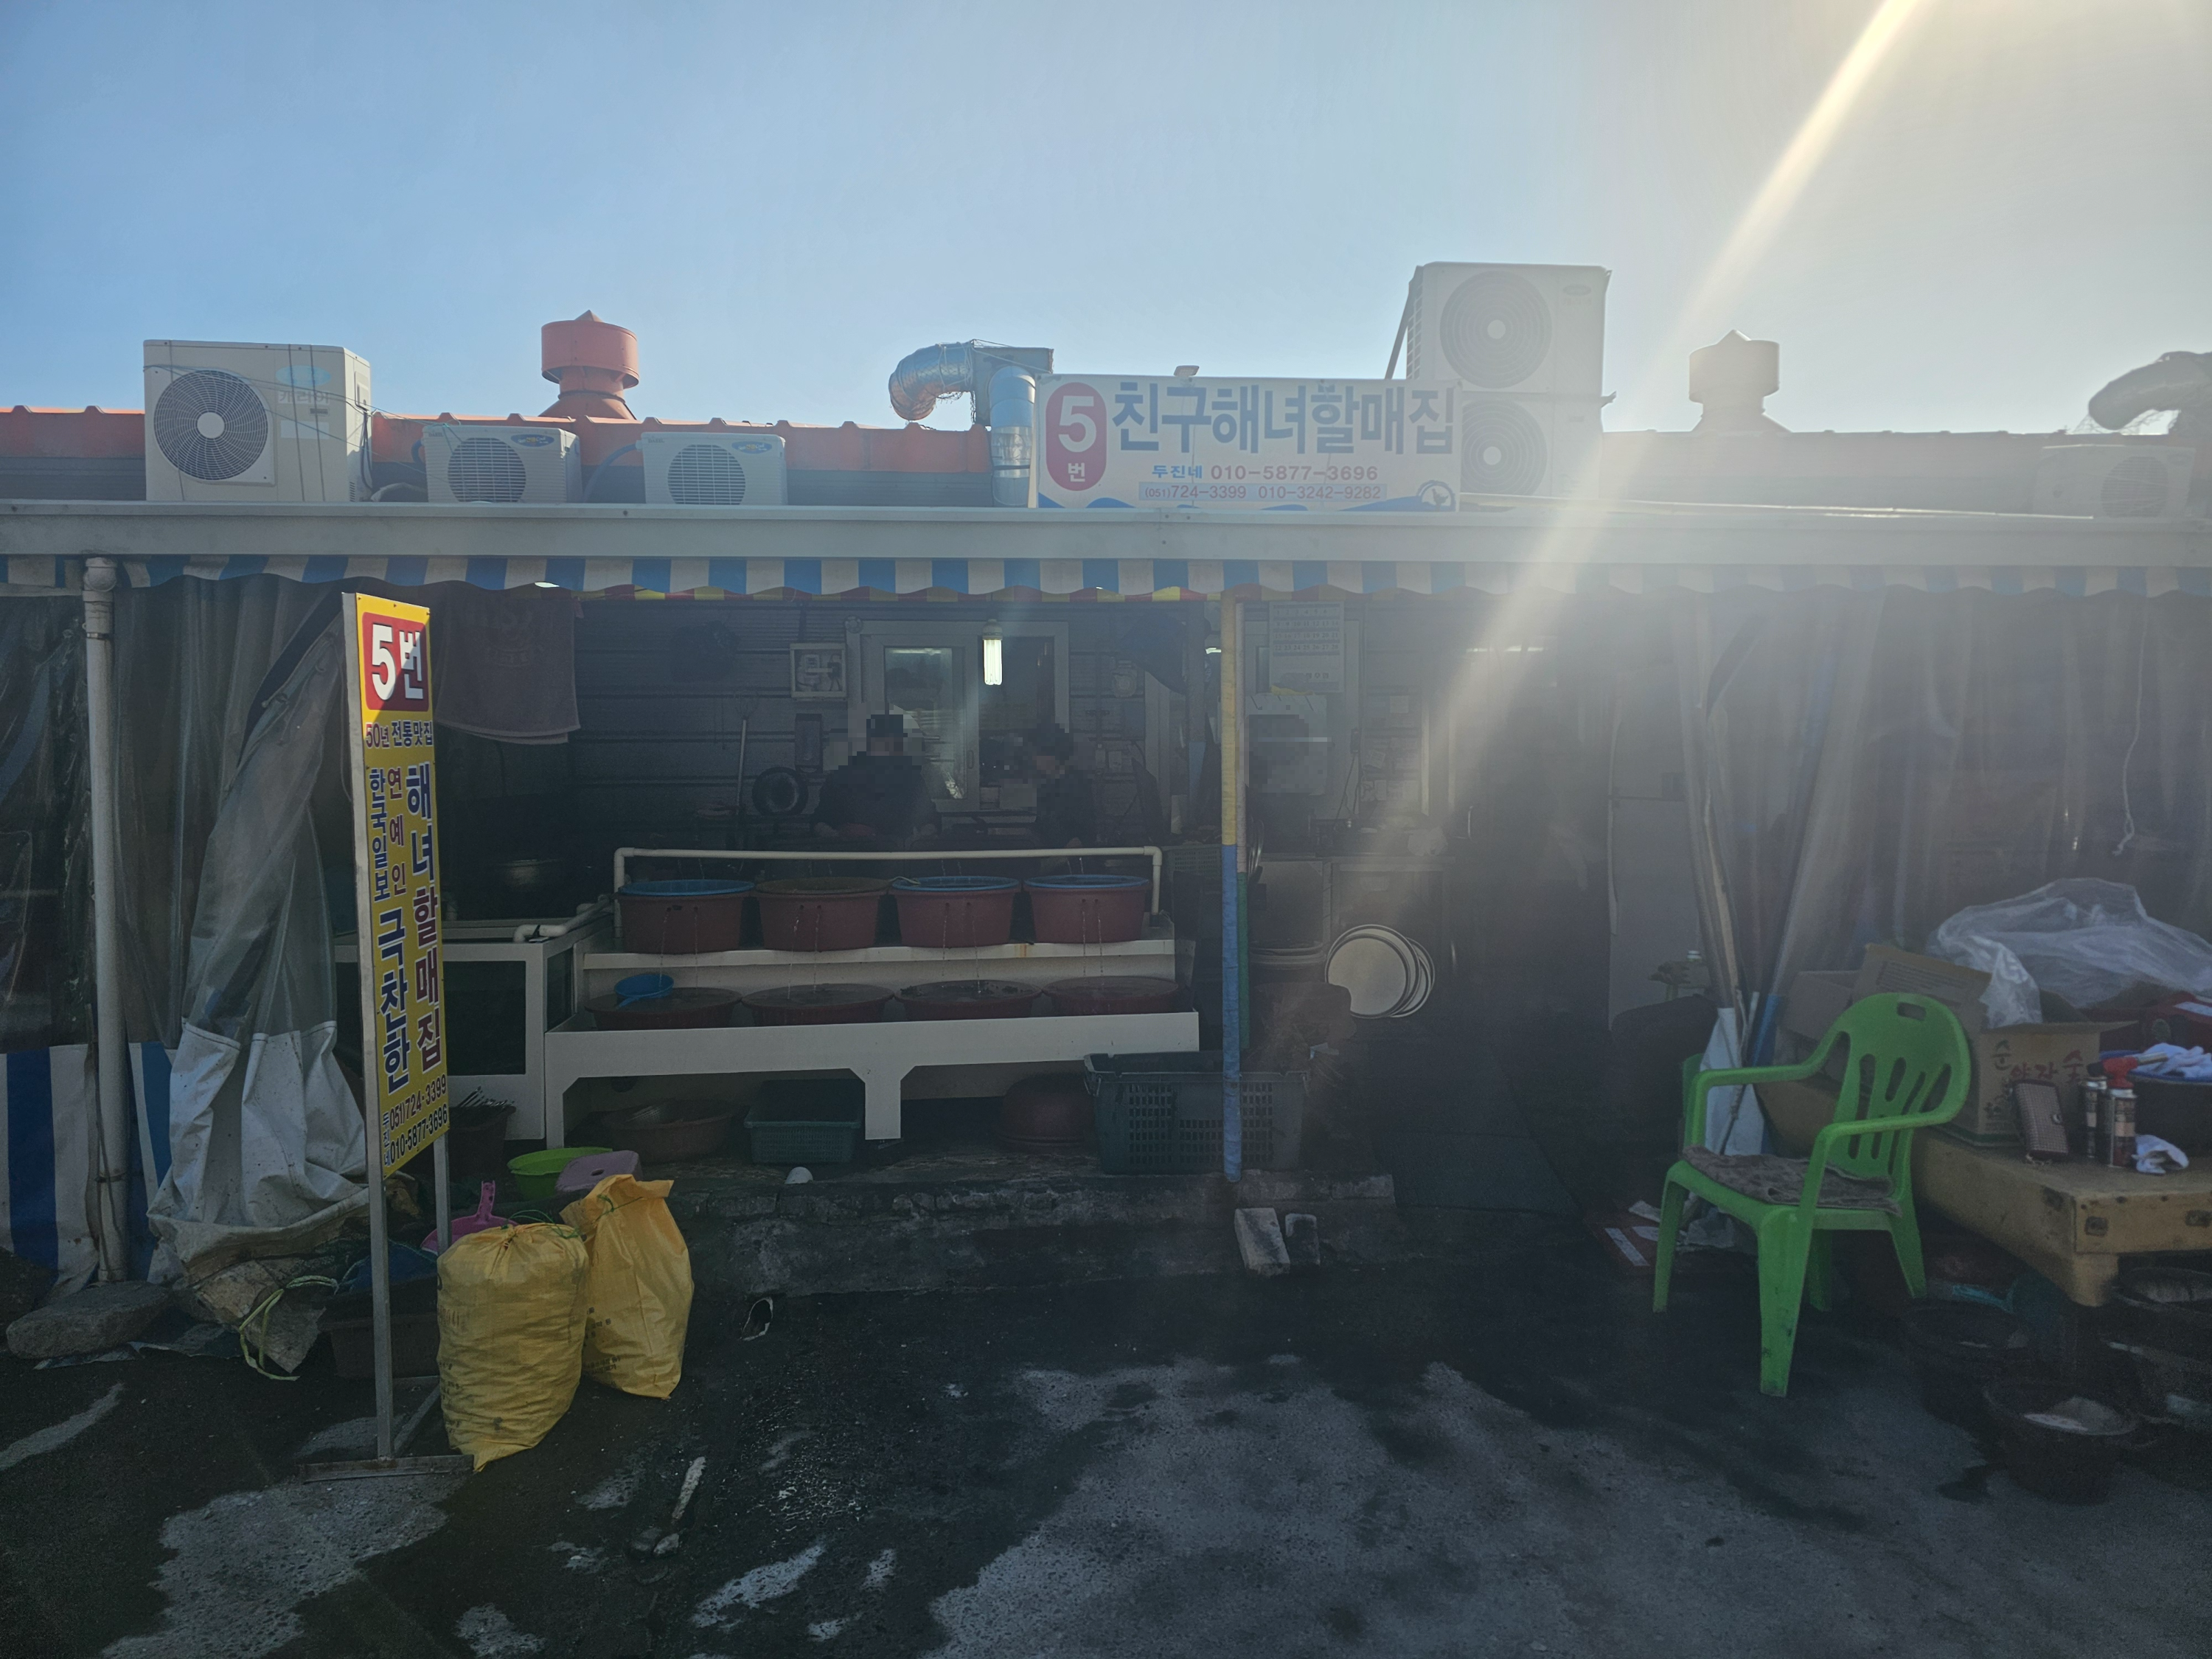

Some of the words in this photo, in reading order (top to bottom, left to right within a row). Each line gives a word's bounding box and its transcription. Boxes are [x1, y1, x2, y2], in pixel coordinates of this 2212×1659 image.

[1058, 395, 1096, 453] 5
[1112, 382, 1454, 454] 친구해녀할매집
[1067, 462, 1087, 483] 번
[1144, 484, 1247, 500] (051)724-3399
[1258, 484, 1381, 500] 010-3242-9282
[1151, 465, 1203, 480] 두진네
[1211, 465, 1378, 481] 010-5877-3696
[372, 623, 424, 700] 5번
[366, 722, 390, 748] 50년
[391, 720, 434, 748] 전통맛집
[369, 768, 391, 903] 한국일보
[387, 766, 406, 897] 연예인
[405, 761, 442, 1074] 해녀할매집
[378, 907, 410, 1096] 극찬한
[383, 1111, 391, 1167] 두진네
[389, 1103, 448, 1166] 010-5877-3696
